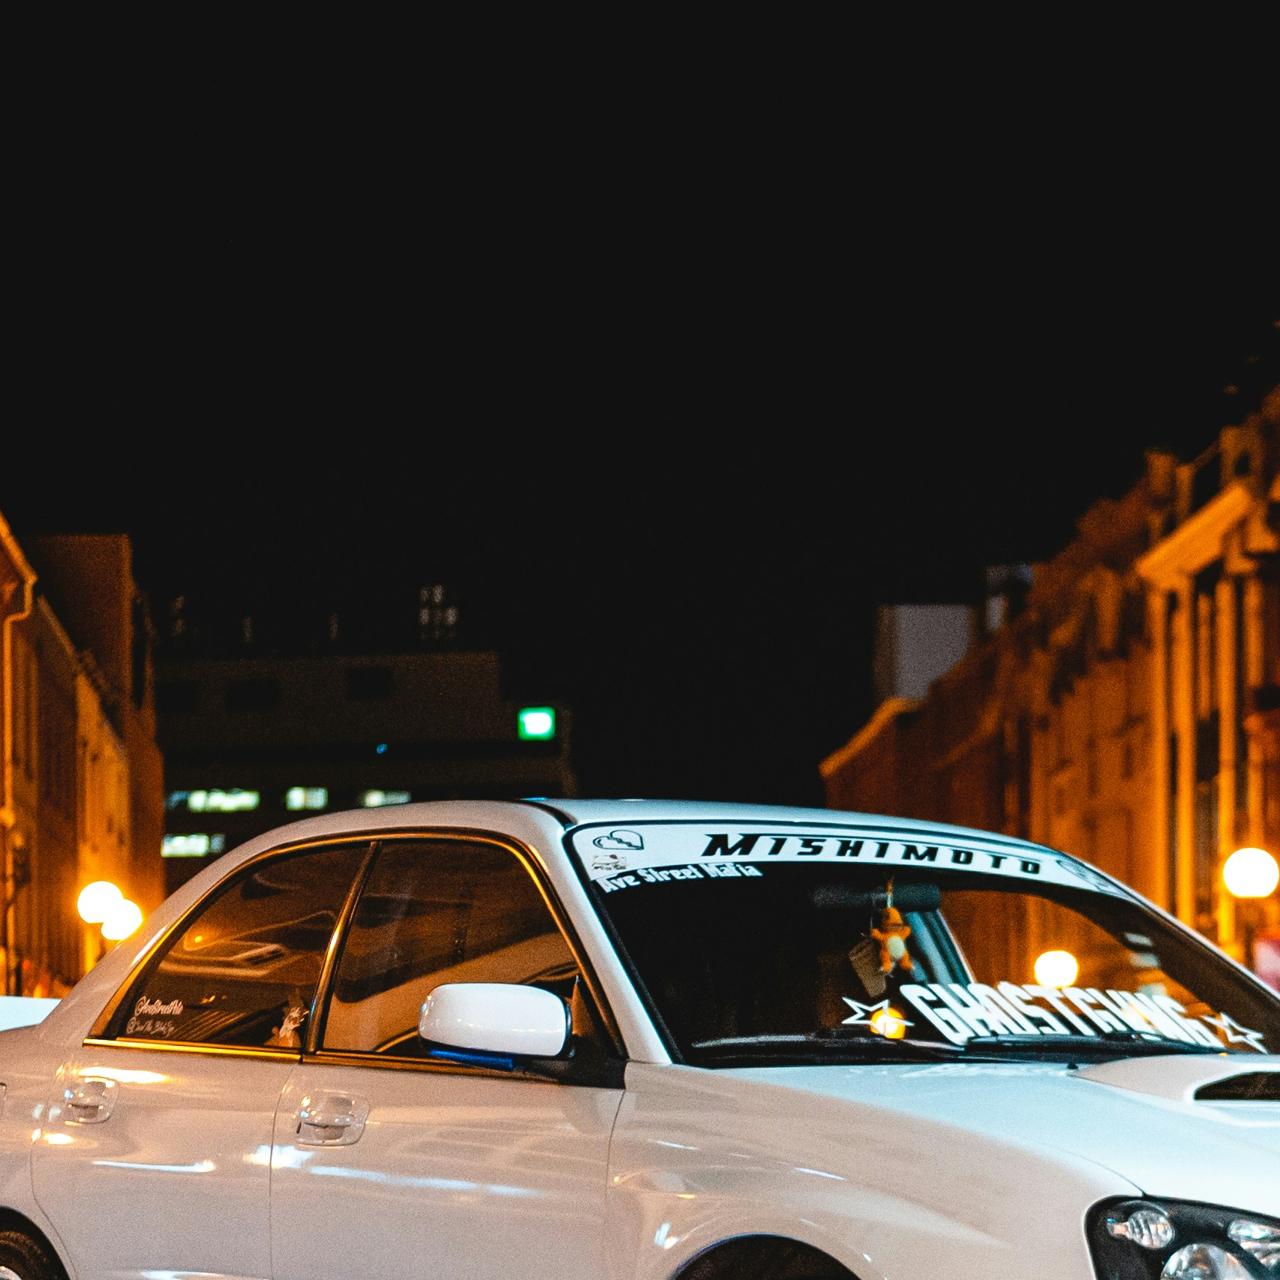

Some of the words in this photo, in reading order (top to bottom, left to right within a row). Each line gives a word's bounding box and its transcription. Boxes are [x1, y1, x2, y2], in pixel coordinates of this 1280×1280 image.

[701, 833, 1041, 875] MISHIMOTO
[637, 865, 704, 884] Street
[699, 862, 763, 878] Mafia
